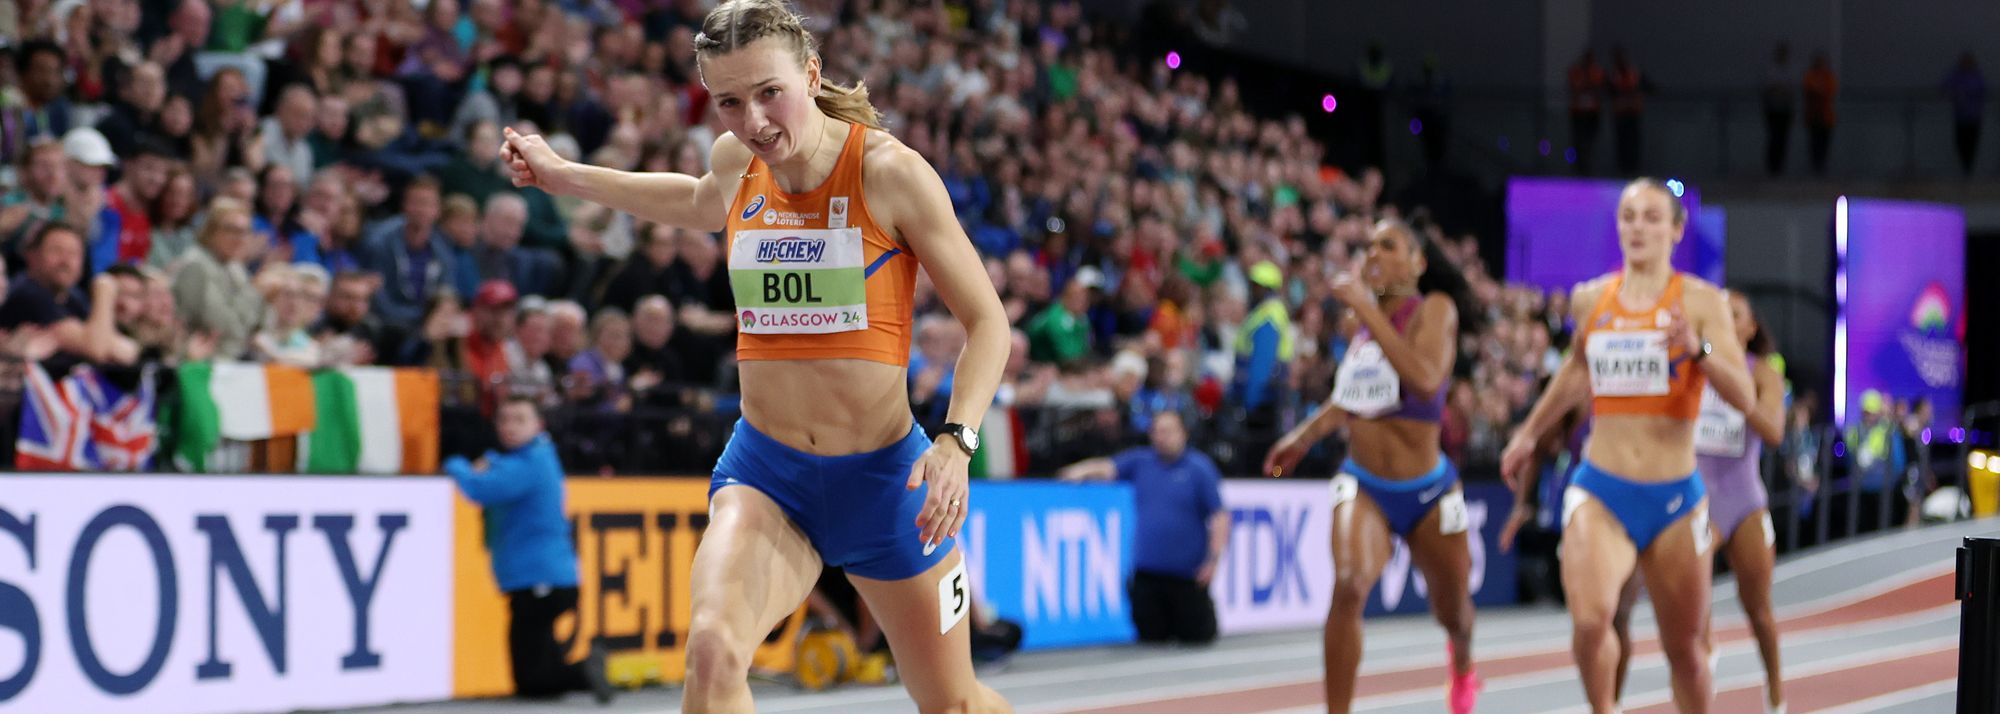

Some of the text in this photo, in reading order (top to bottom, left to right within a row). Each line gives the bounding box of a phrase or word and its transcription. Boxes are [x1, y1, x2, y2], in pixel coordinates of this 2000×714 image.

[777, 218, 805, 226] LOTERIJ
[757, 239, 825, 262] HI-CHEW
[763, 272, 822, 303] BOL
[760, 311, 862, 327] GLASGOW 24
[1022, 510, 1122, 622] NTN
[1226, 507, 1310, 606] TDK
[952, 573, 964, 616] 5
